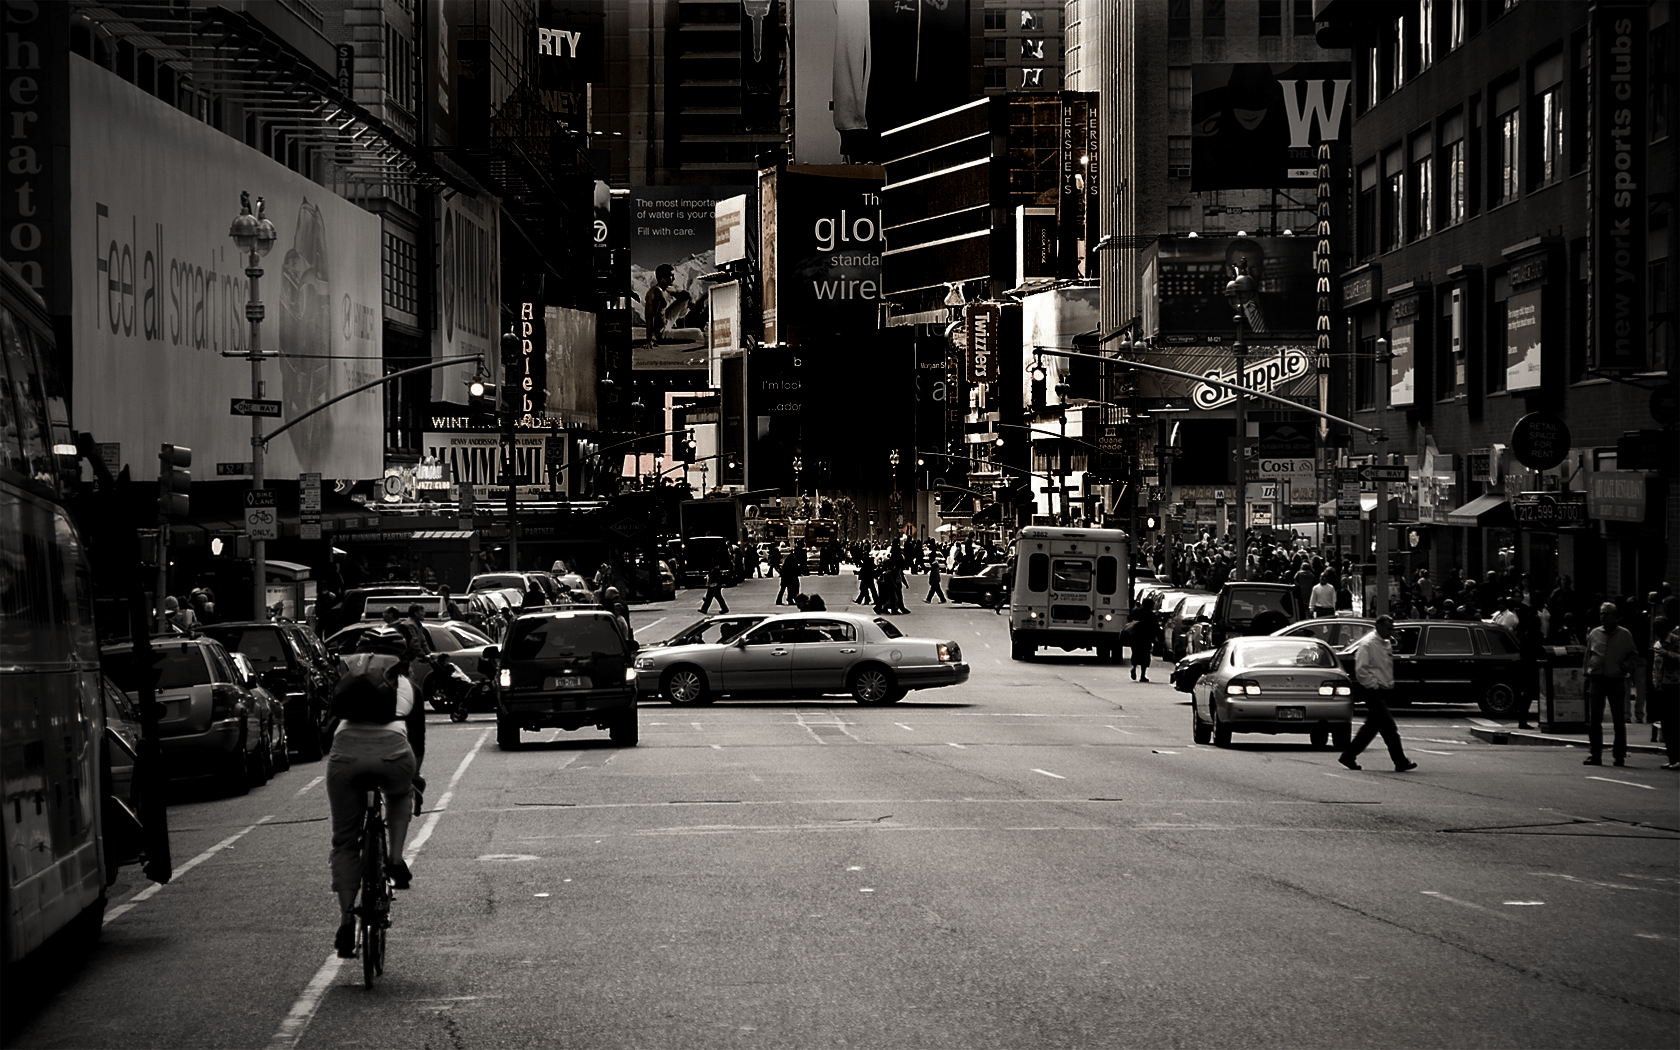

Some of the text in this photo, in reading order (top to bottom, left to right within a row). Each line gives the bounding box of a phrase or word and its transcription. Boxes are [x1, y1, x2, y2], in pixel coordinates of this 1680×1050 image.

[4, 0, 44, 289] Sheraton
[1610, 17, 1637, 357] new york sports clubs
[636, 198, 653, 208] The
[655, 199, 678, 208] most
[862, 193, 881, 205] Th
[637, 211, 647, 219] of
[649, 211, 673, 219] water
[676, 211, 684, 219] is
[687, 212, 708, 221] your
[637, 227, 650, 236] Fill
[652, 227, 671, 236] with
[96, 202, 137, 338] Feel
[143, 222, 165, 341] all
[170, 213, 217, 351] smart
[974, 312, 991, 378] Twizzlers
[1529, 422, 1558, 431] RETAIL
[1529, 432, 1557, 440] SPACE
[1099, 443, 1122, 451] reade
[1534, 441, 1553, 449] FOR
[547, 447, 562, 458] 30
[1531, 450, 1554, 459] RENT
[226, 464, 235, 474] 52
[1365, 469, 1380, 477] ONE
[1387, 469, 1403, 477] WAY
[1519, 505, 1578, 520] 212.599.3700
[525, 527, 555, 536] PARTNER
[340, 534, 350, 542] MY
[351, 533, 381, 541] RUNNING
[382, 532, 413, 541] PARTNER
